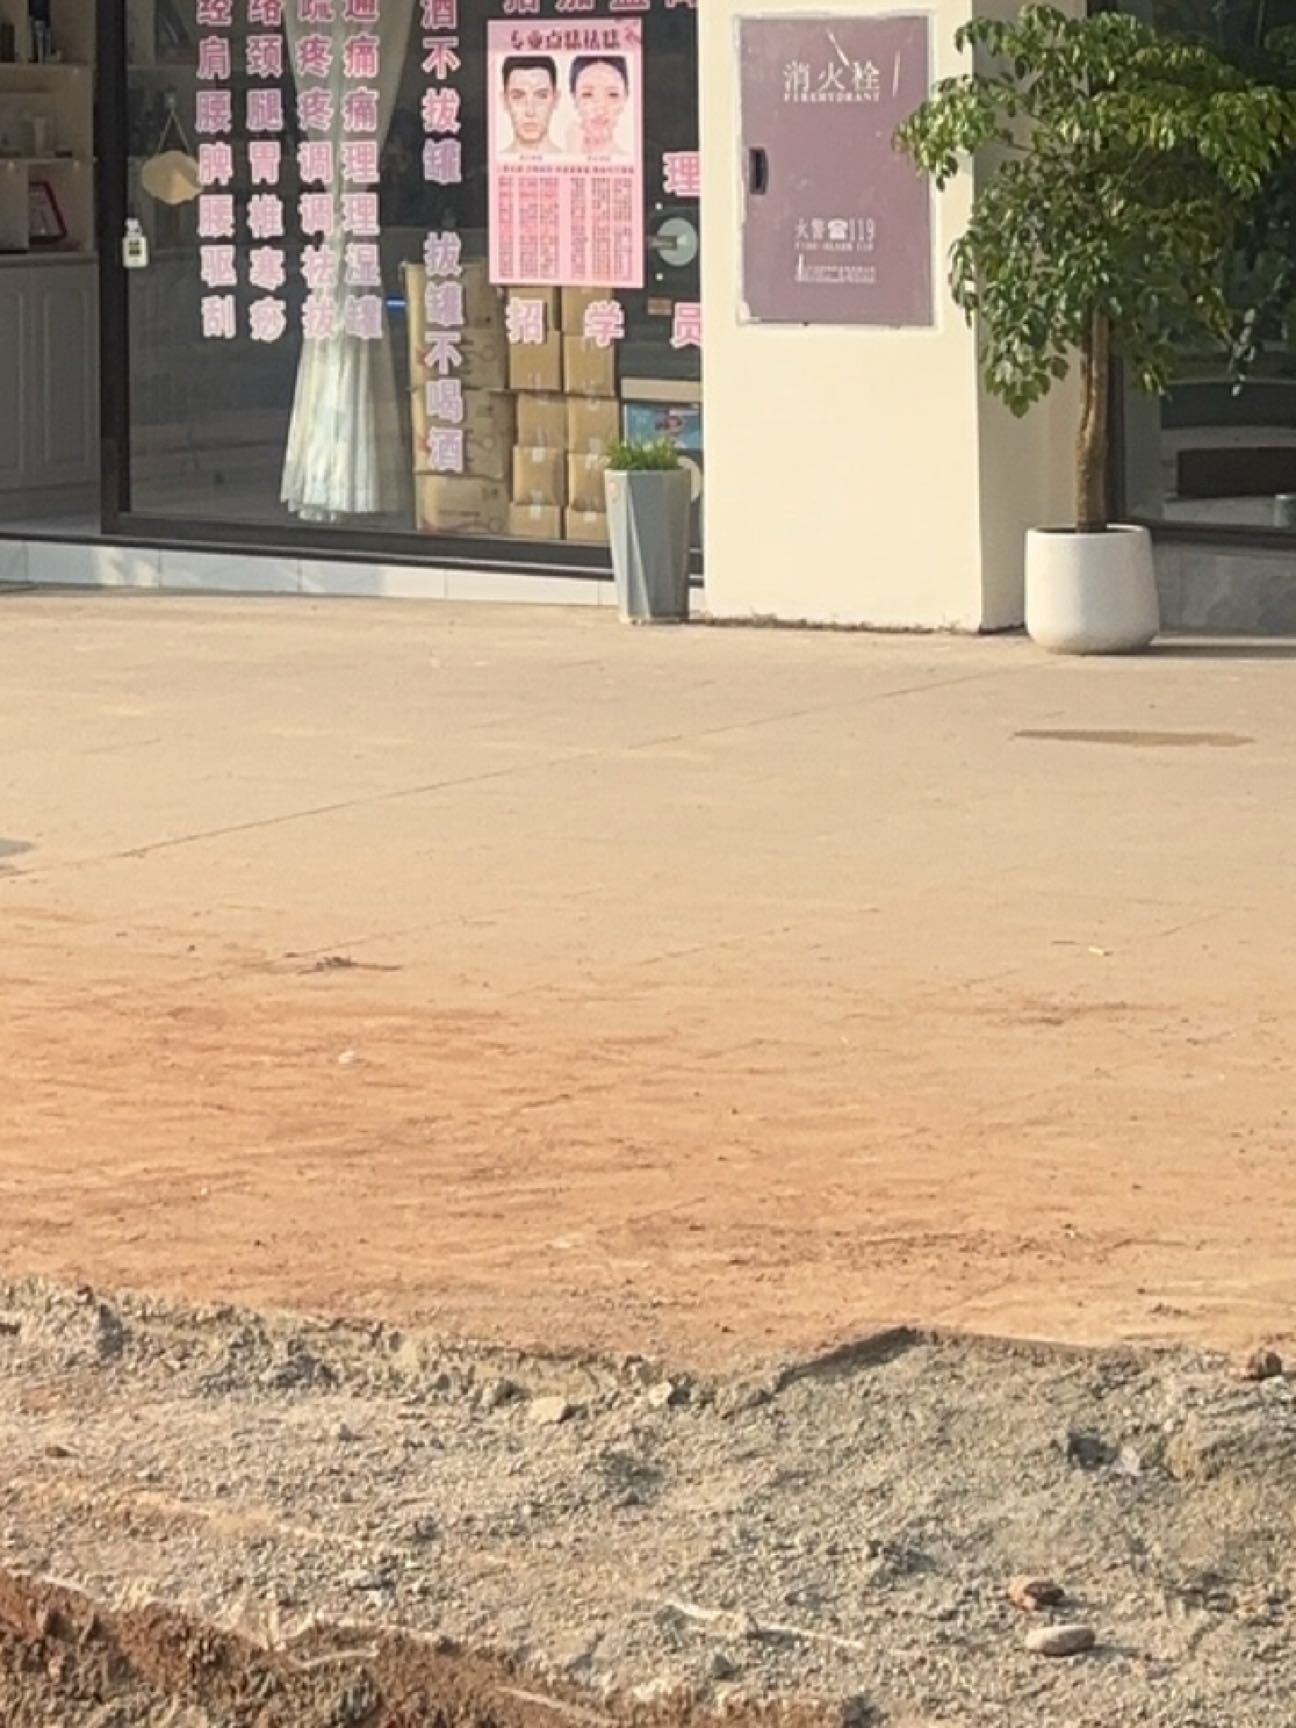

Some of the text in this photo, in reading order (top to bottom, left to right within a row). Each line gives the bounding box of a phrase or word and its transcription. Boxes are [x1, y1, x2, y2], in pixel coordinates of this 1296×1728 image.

[195, 31, 380, 80] 肩颈疼痛
[782, 59, 881, 93] 消火栓
[195, 86, 380, 134] 腰腿疼痛
[197, 140, 381, 185] 脾胃调理
[199, 241, 381, 291] 驱寒祛湿
[201, 293, 384, 343] 刮痧拔罐
[505, 296, 703, 349] 招学员
[423, 232, 464, 473] 拔罐不喝酒
